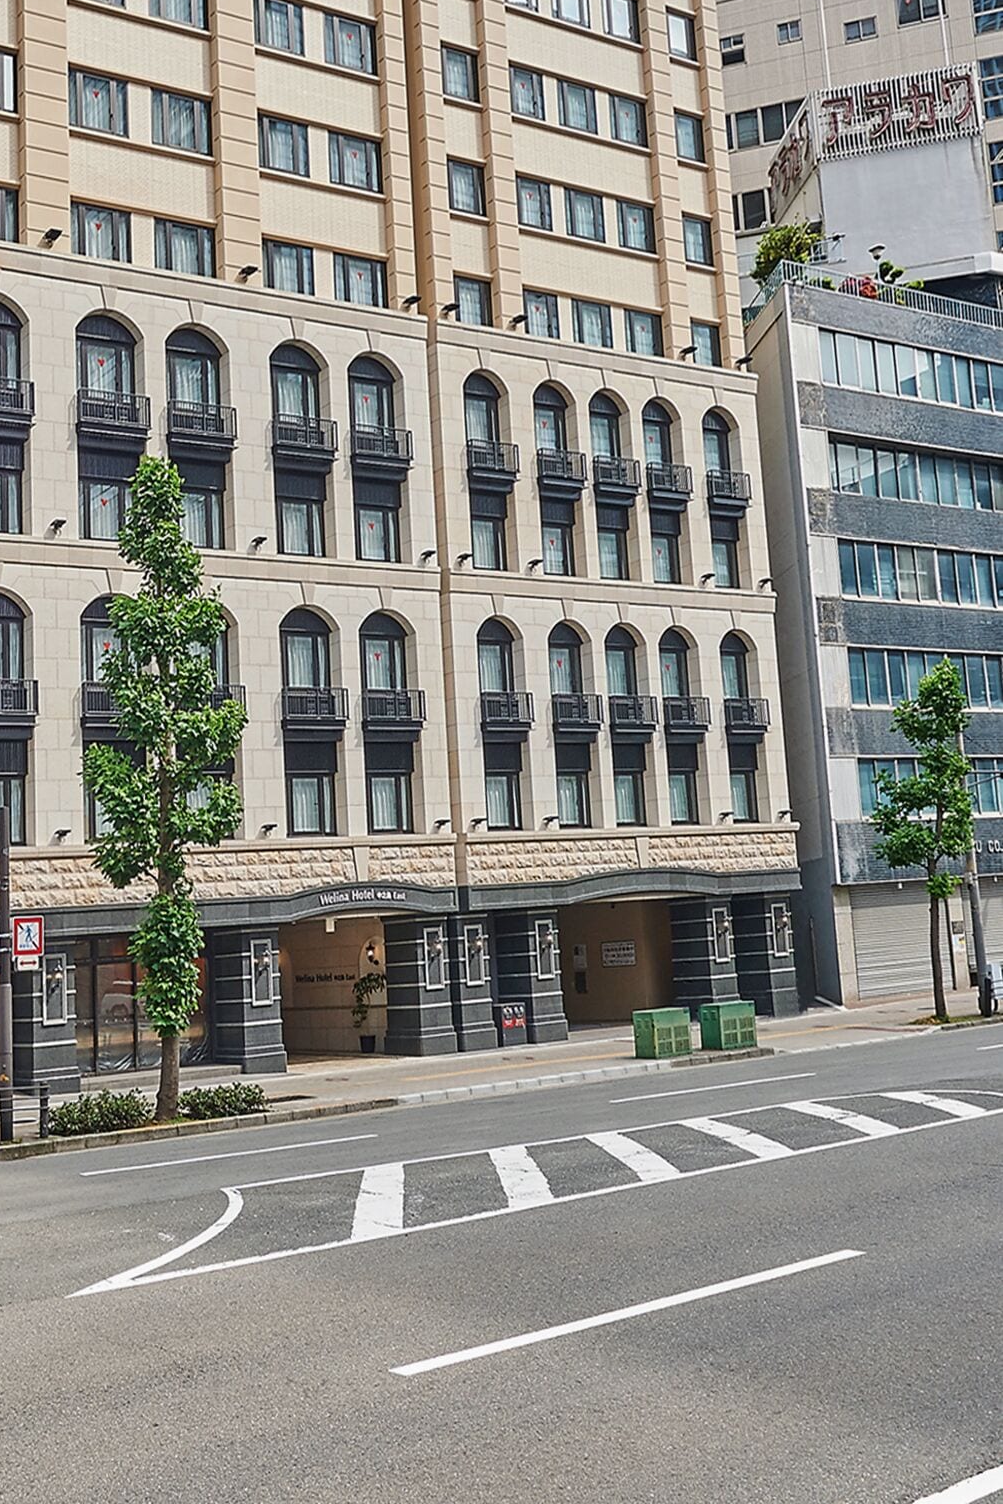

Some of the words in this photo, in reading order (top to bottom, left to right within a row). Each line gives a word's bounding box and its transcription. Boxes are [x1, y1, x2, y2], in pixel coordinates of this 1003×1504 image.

[821, 73, 975, 146] アラカワ
[351, 888, 374, 901] Hotel
